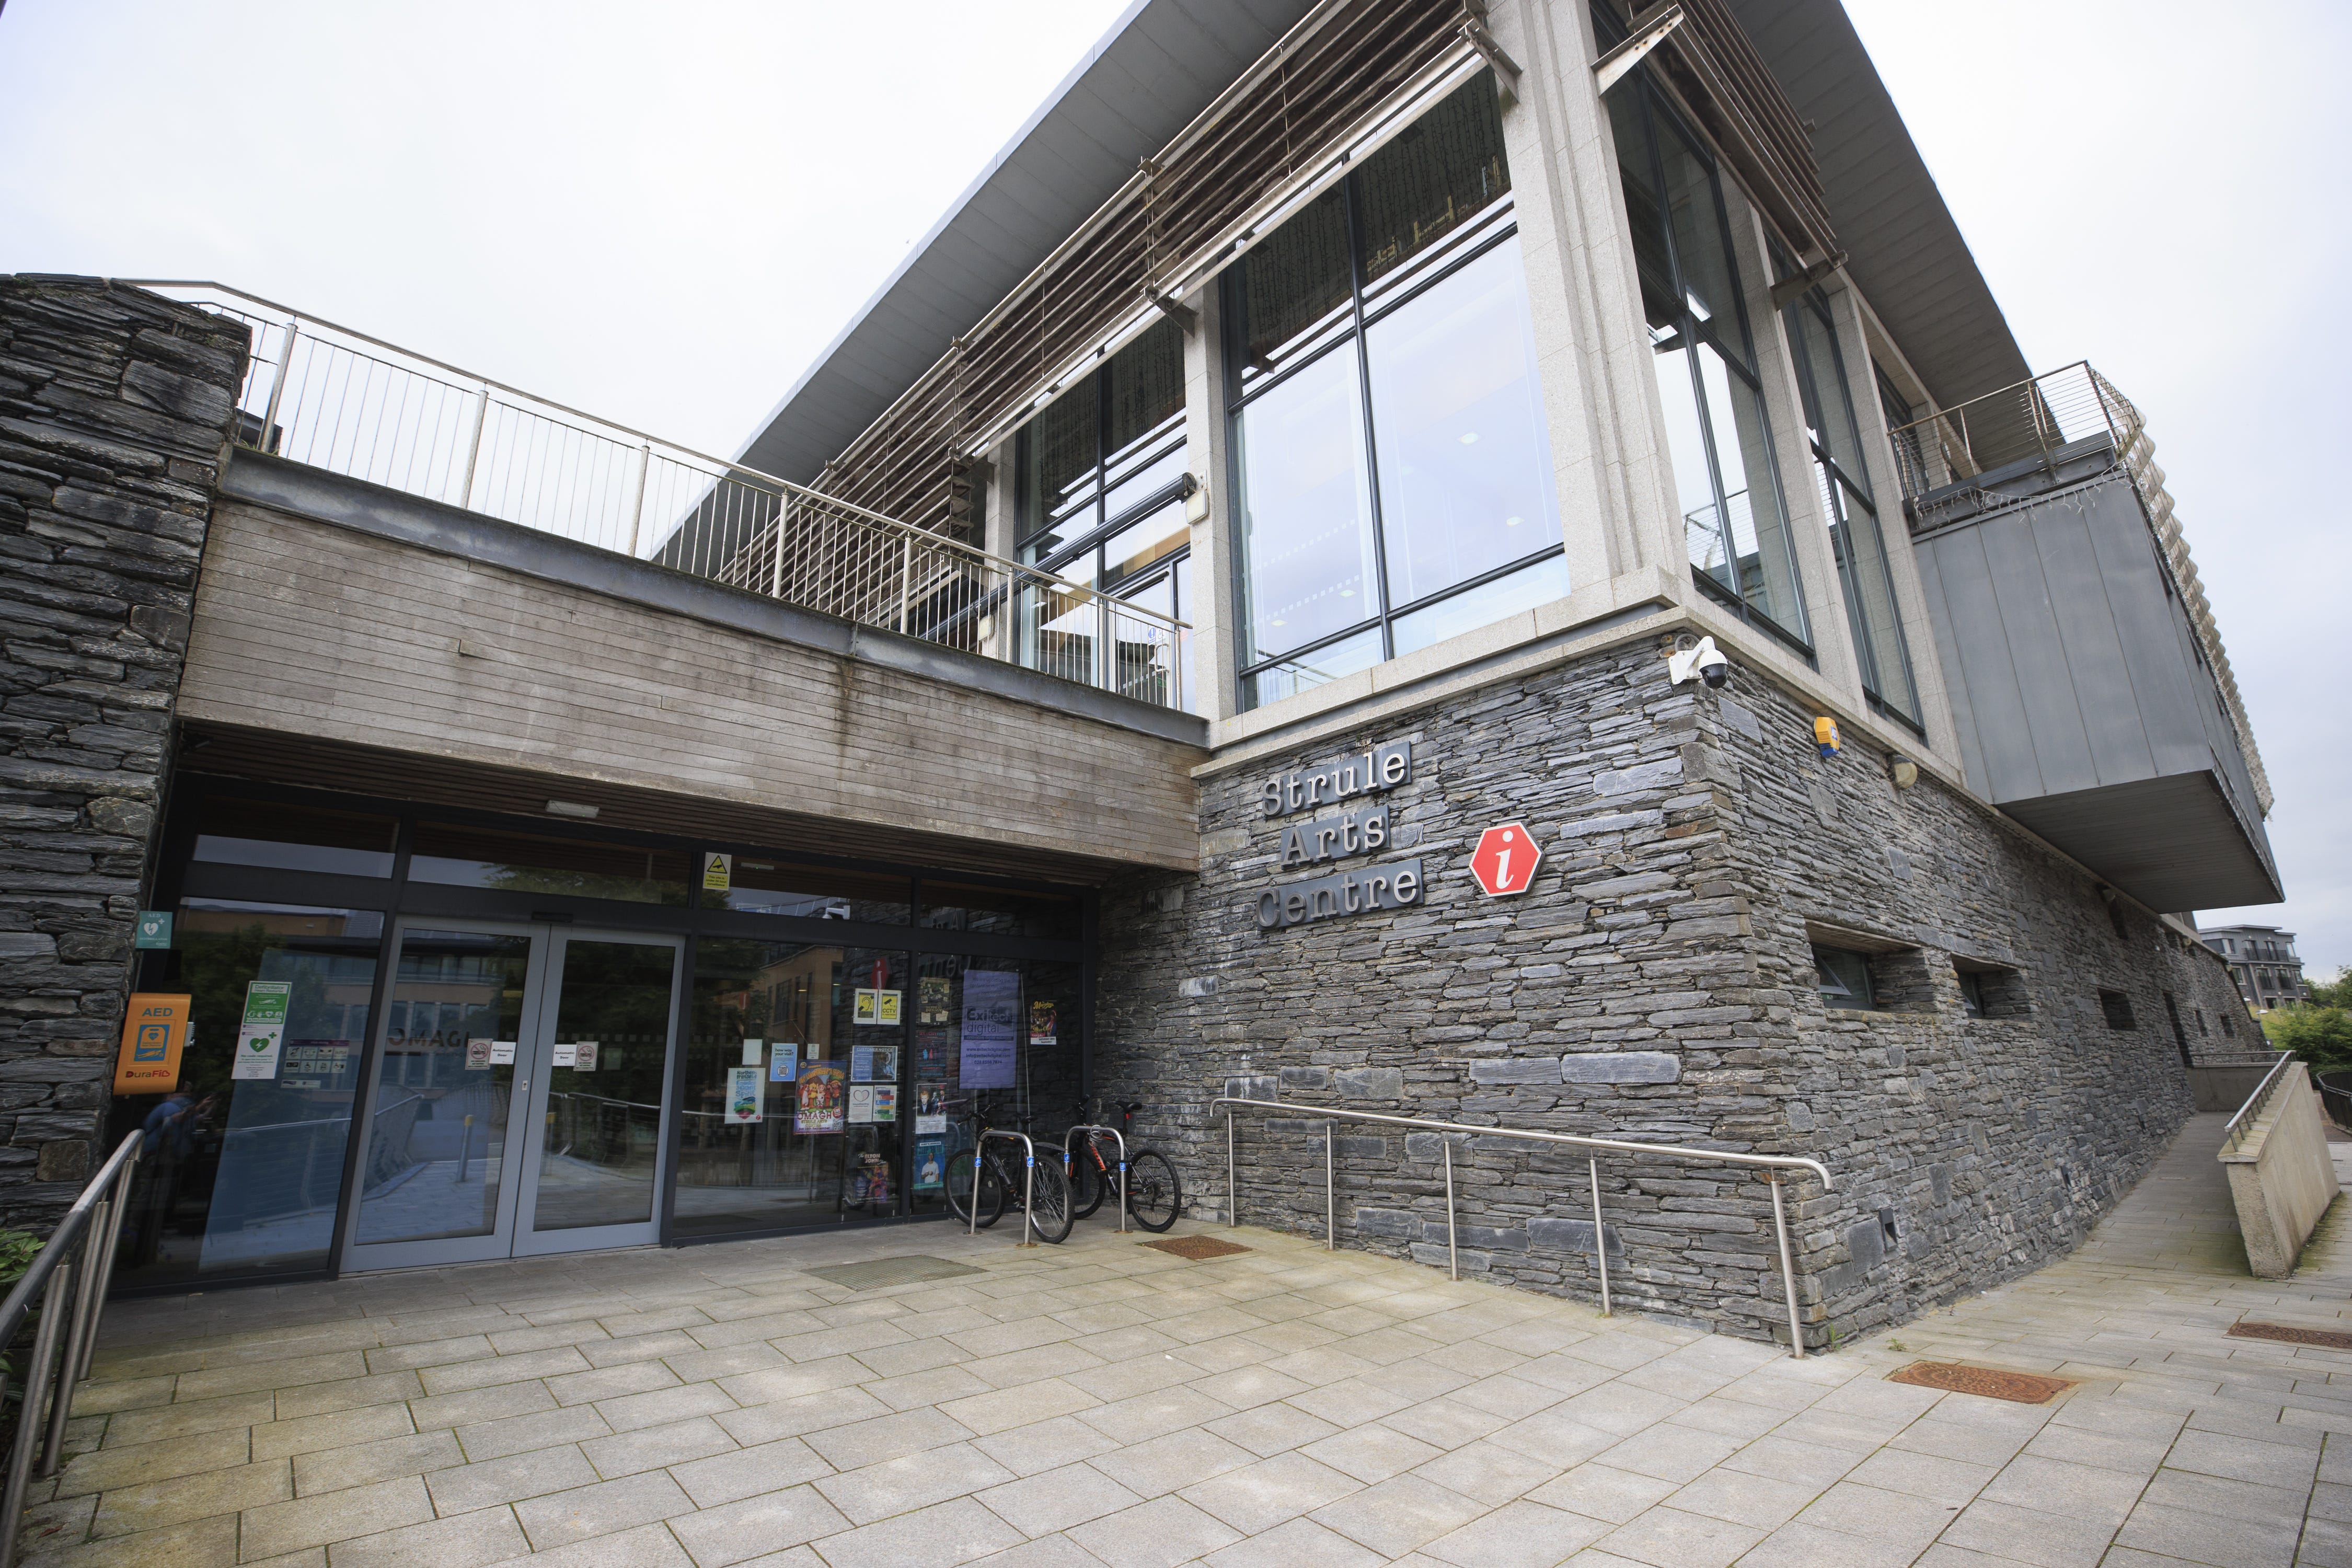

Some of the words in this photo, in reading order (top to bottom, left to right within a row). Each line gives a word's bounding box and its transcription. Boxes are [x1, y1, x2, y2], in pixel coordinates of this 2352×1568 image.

[1262, 752, 1407, 818] Strule
[1281, 814, 1387, 867] Arts
[1495, 830, 1515, 890] i
[1255, 870, 1420, 928] Centre
[142, 1008, 173, 1017] AED
[967, 1008, 1013, 1021] Exitech
[967, 1021, 999, 1035] digital
[387, 1028, 470, 1047] OMAG
